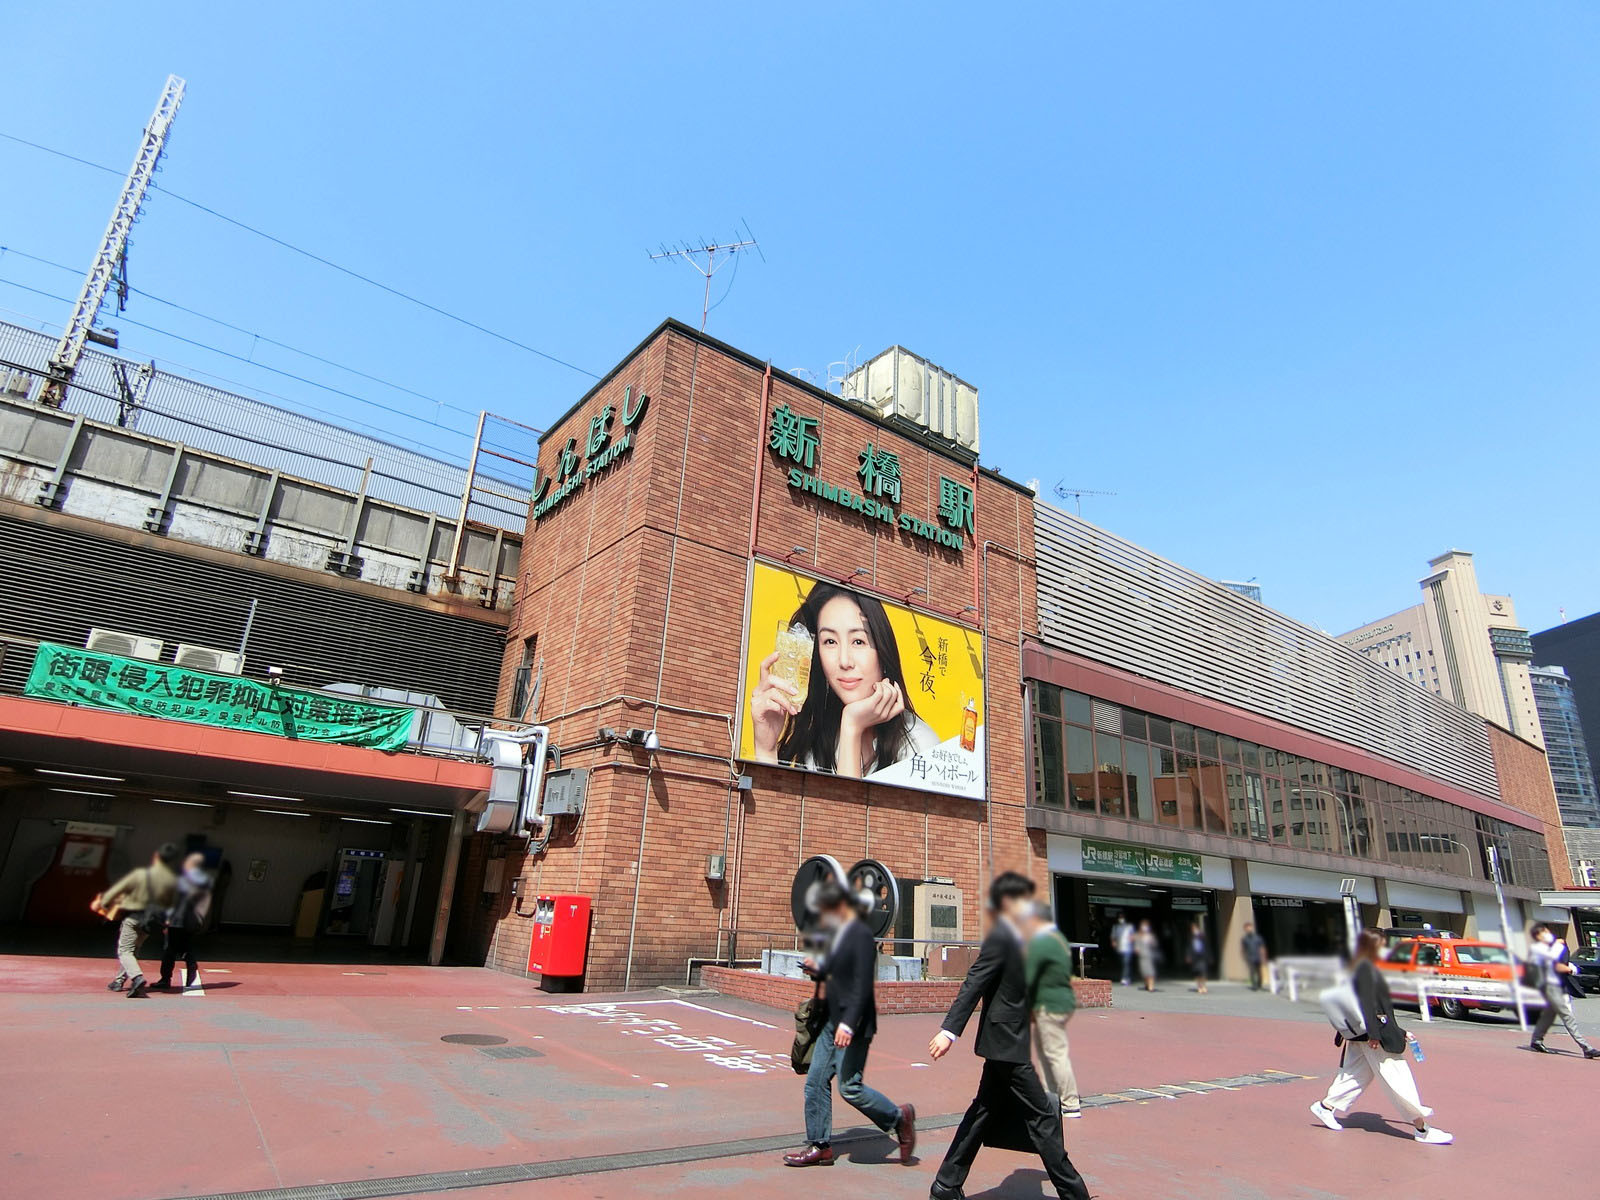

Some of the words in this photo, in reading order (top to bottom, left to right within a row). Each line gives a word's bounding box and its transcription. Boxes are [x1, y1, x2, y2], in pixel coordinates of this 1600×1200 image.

[532, 384, 647, 502] しんばし
[769, 403, 975, 535] 新橋駅
[533, 471, 583, 520] SHIMBASHI
[585, 432, 631, 479] STATION
[787, 468, 894, 525] SHIMBASHI
[897, 513, 965, 552] STATION
[919, 646, 937, 700] 今夜、
[936, 636, 949, 677] 新橋で
[910, 753, 979, 783] 角ハイボール
[1082, 846, 1097, 861] JR
[1146, 854, 1159, 868] JR
